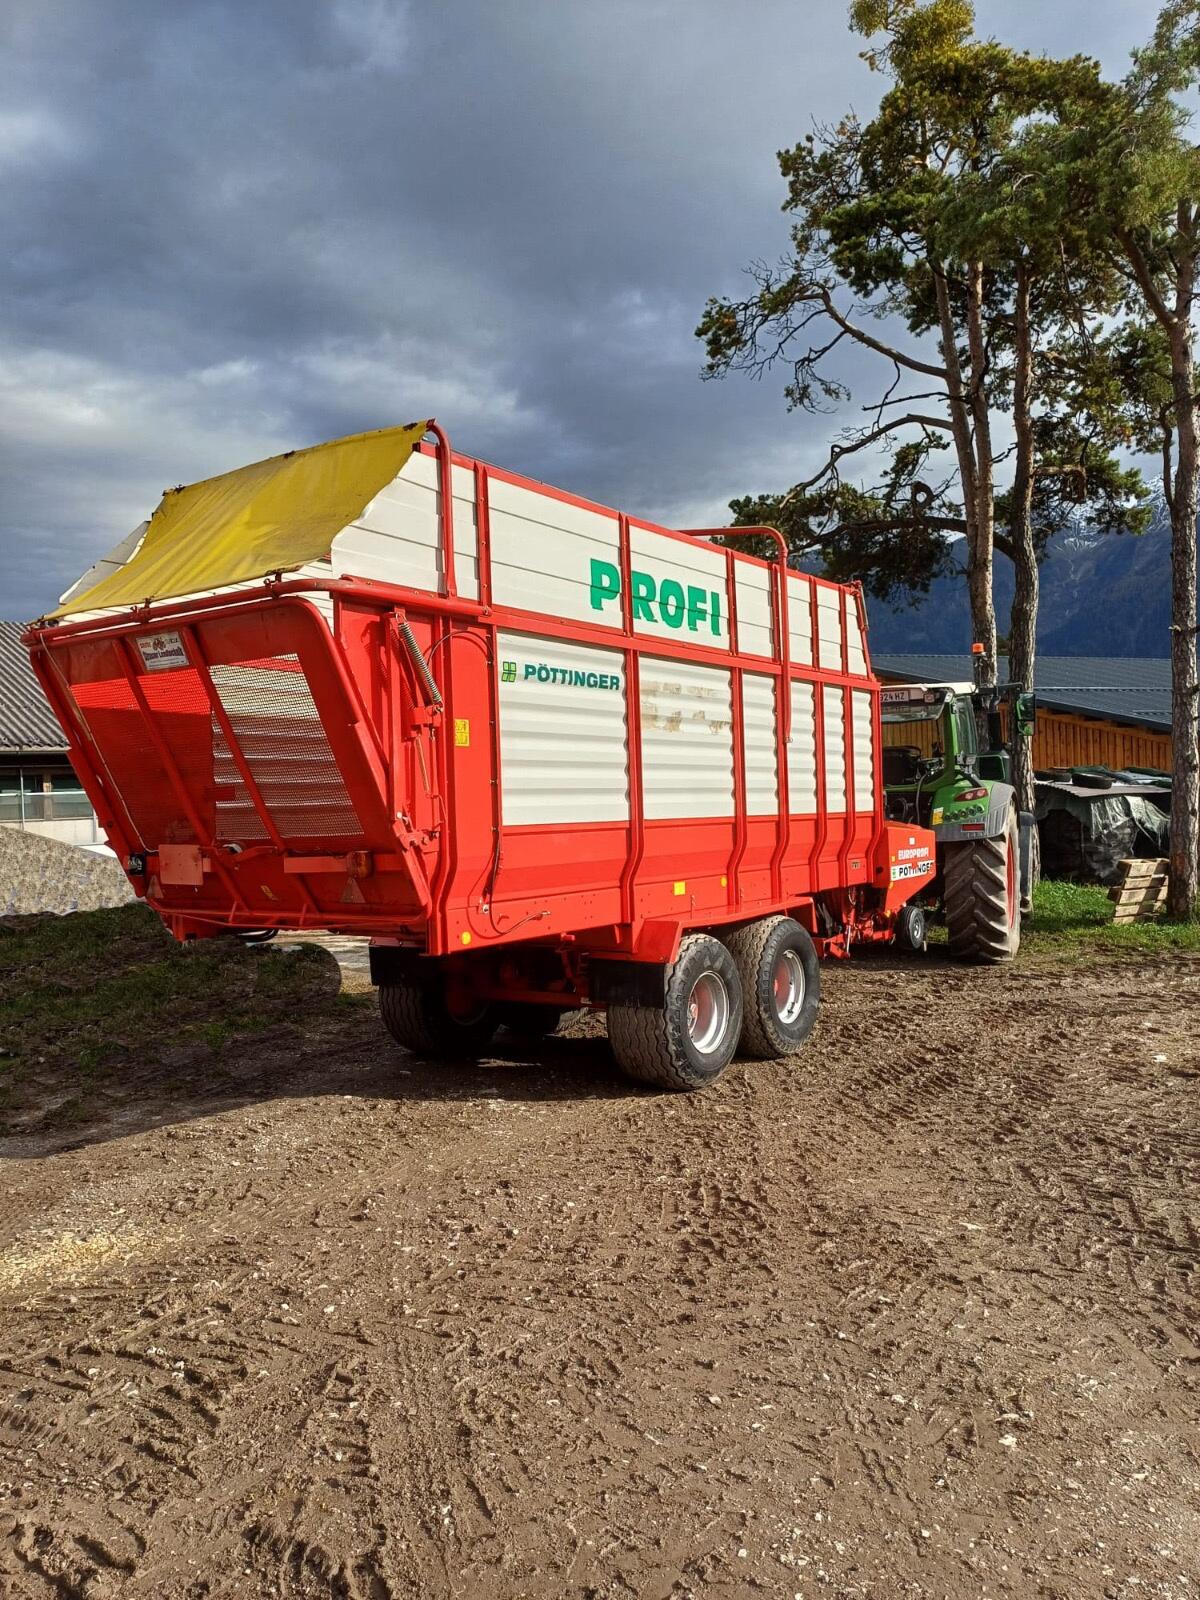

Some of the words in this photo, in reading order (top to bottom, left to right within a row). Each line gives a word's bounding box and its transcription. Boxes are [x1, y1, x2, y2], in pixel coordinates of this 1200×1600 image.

[590, 558, 721, 636] PROFI
[524, 663, 620, 690] PÖTTINGER
[895, 692, 905, 700] HZ
